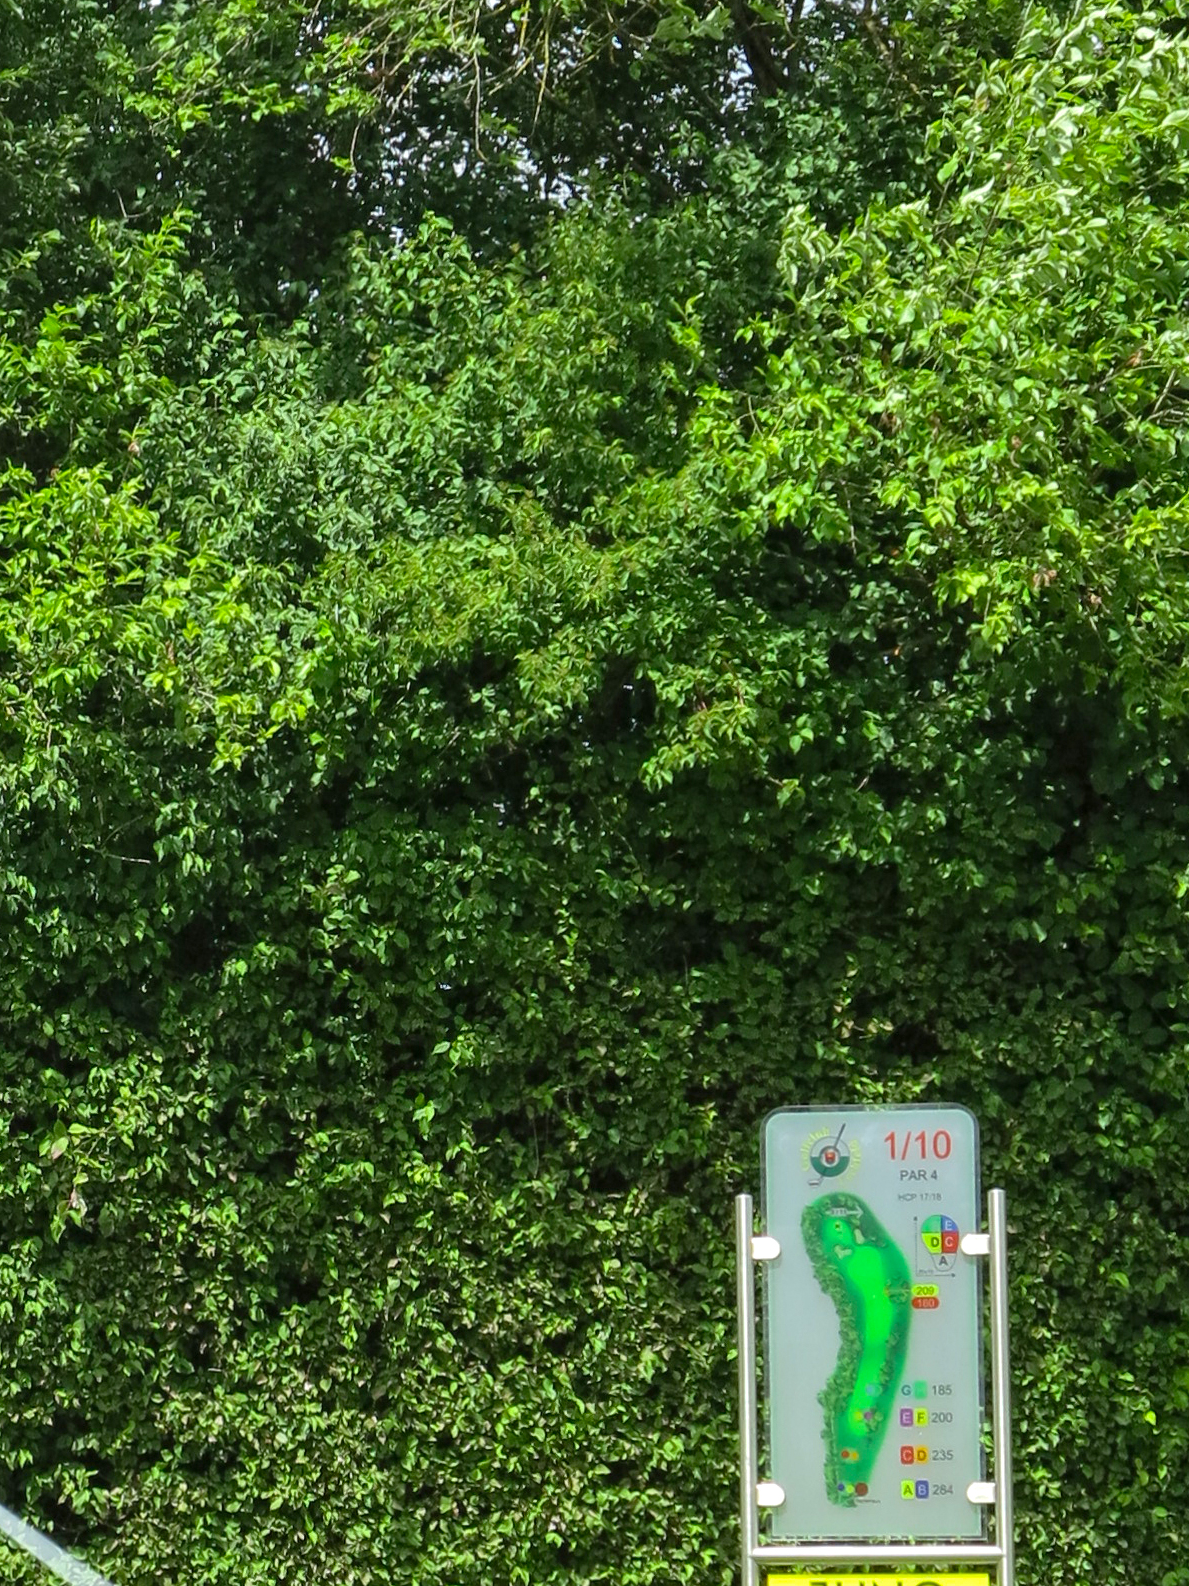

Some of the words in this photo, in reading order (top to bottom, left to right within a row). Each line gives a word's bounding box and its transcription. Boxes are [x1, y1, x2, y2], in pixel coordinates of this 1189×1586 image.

[884, 1130, 951, 1160] 1/10
[900, 1169, 927, 1180] PAR
[930, 1169, 938, 1180] 4
[898, 1193, 917, 1201] HCP
[945, 1220, 953, 1231] E
[931, 1236, 940, 1248] D
[944, 1236, 954, 1248] C
[938, 1255, 948, 1266] A
[916, 1286, 935, 1296] 209
[901, 1384, 912, 1396] G
[932, 1384, 953, 1396] 185
[903, 1411, 911, 1424] E
[917, 1411, 925, 1423] F
[931, 1412, 953, 1424] 200
[902, 1450, 913, 1461] C
[917, 1450, 927, 1461] D
[932, 1449, 954, 1461] 235
[903, 1484, 913, 1496] A
[918, 1484, 927, 1496] B
